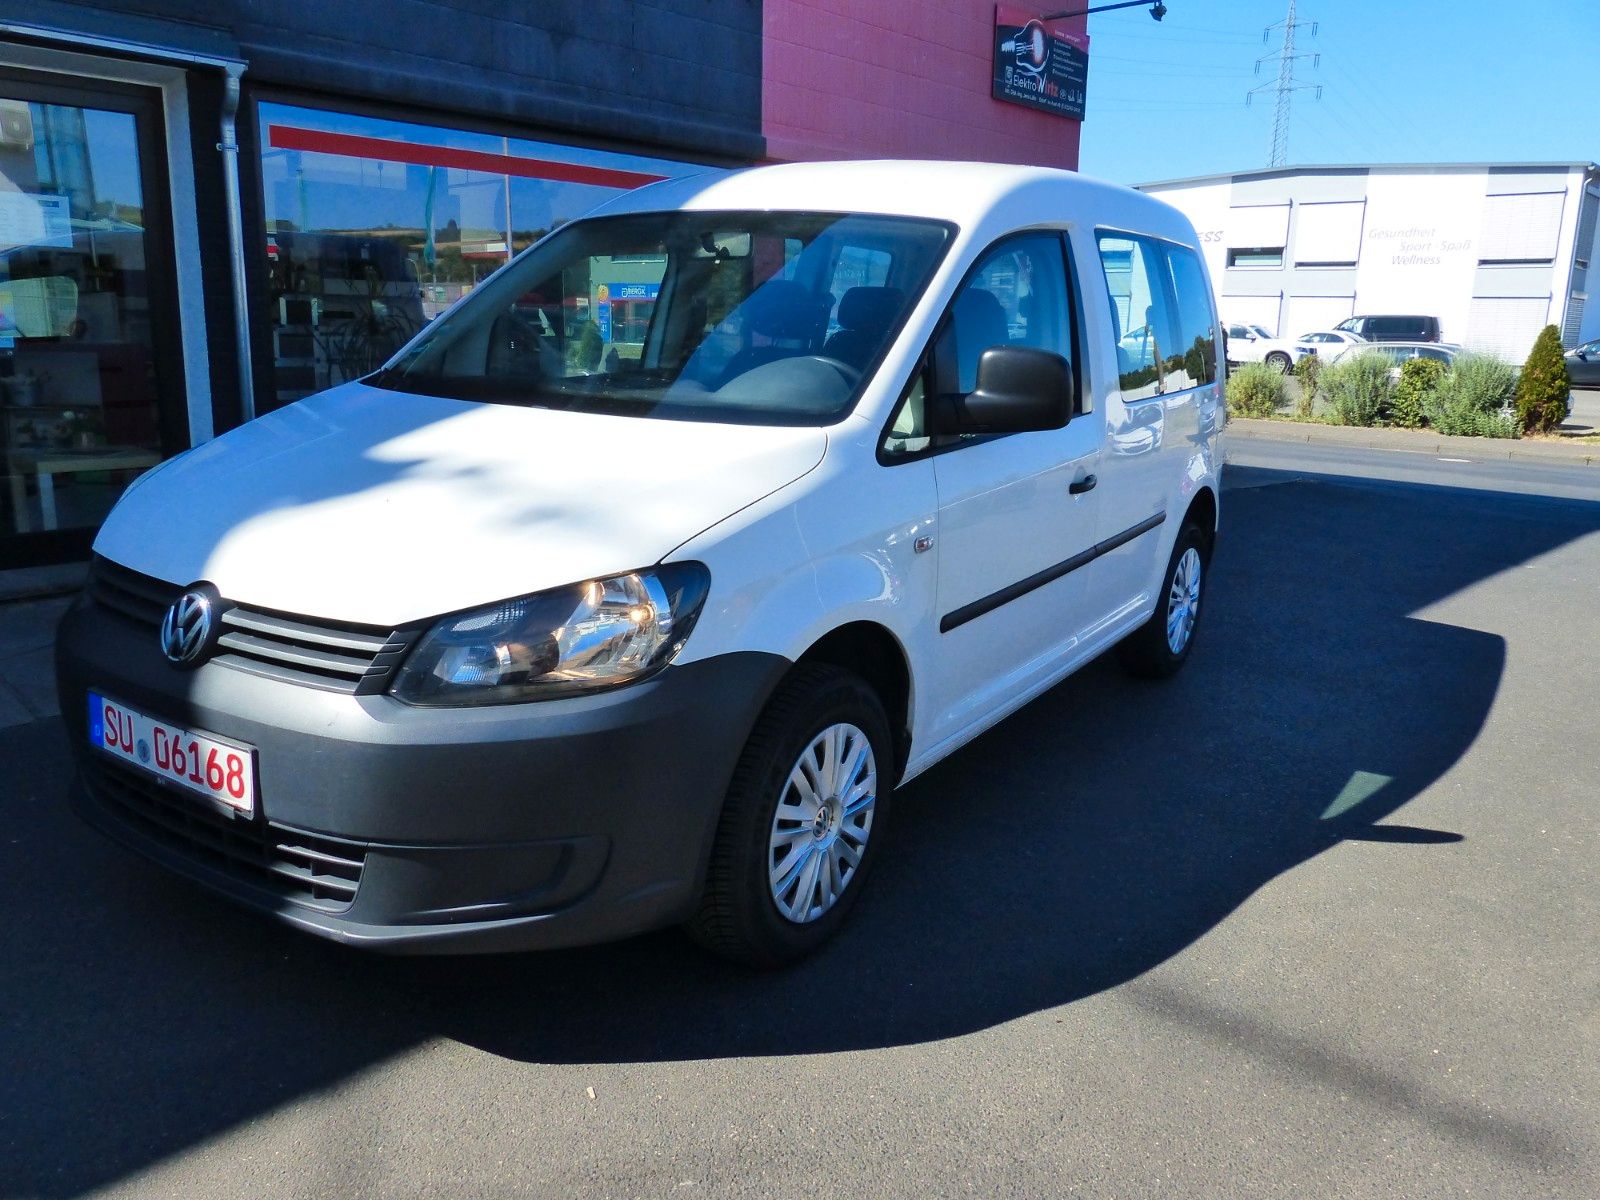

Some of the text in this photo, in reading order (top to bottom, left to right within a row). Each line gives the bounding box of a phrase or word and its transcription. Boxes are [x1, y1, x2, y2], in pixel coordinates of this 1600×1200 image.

[1369, 227, 1436, 239] Gesundheit
[1399, 240, 1472, 253] Sport Spaß
[1391, 254, 1441, 265] Wellness
[105, 705, 245, 798] SU 06168
